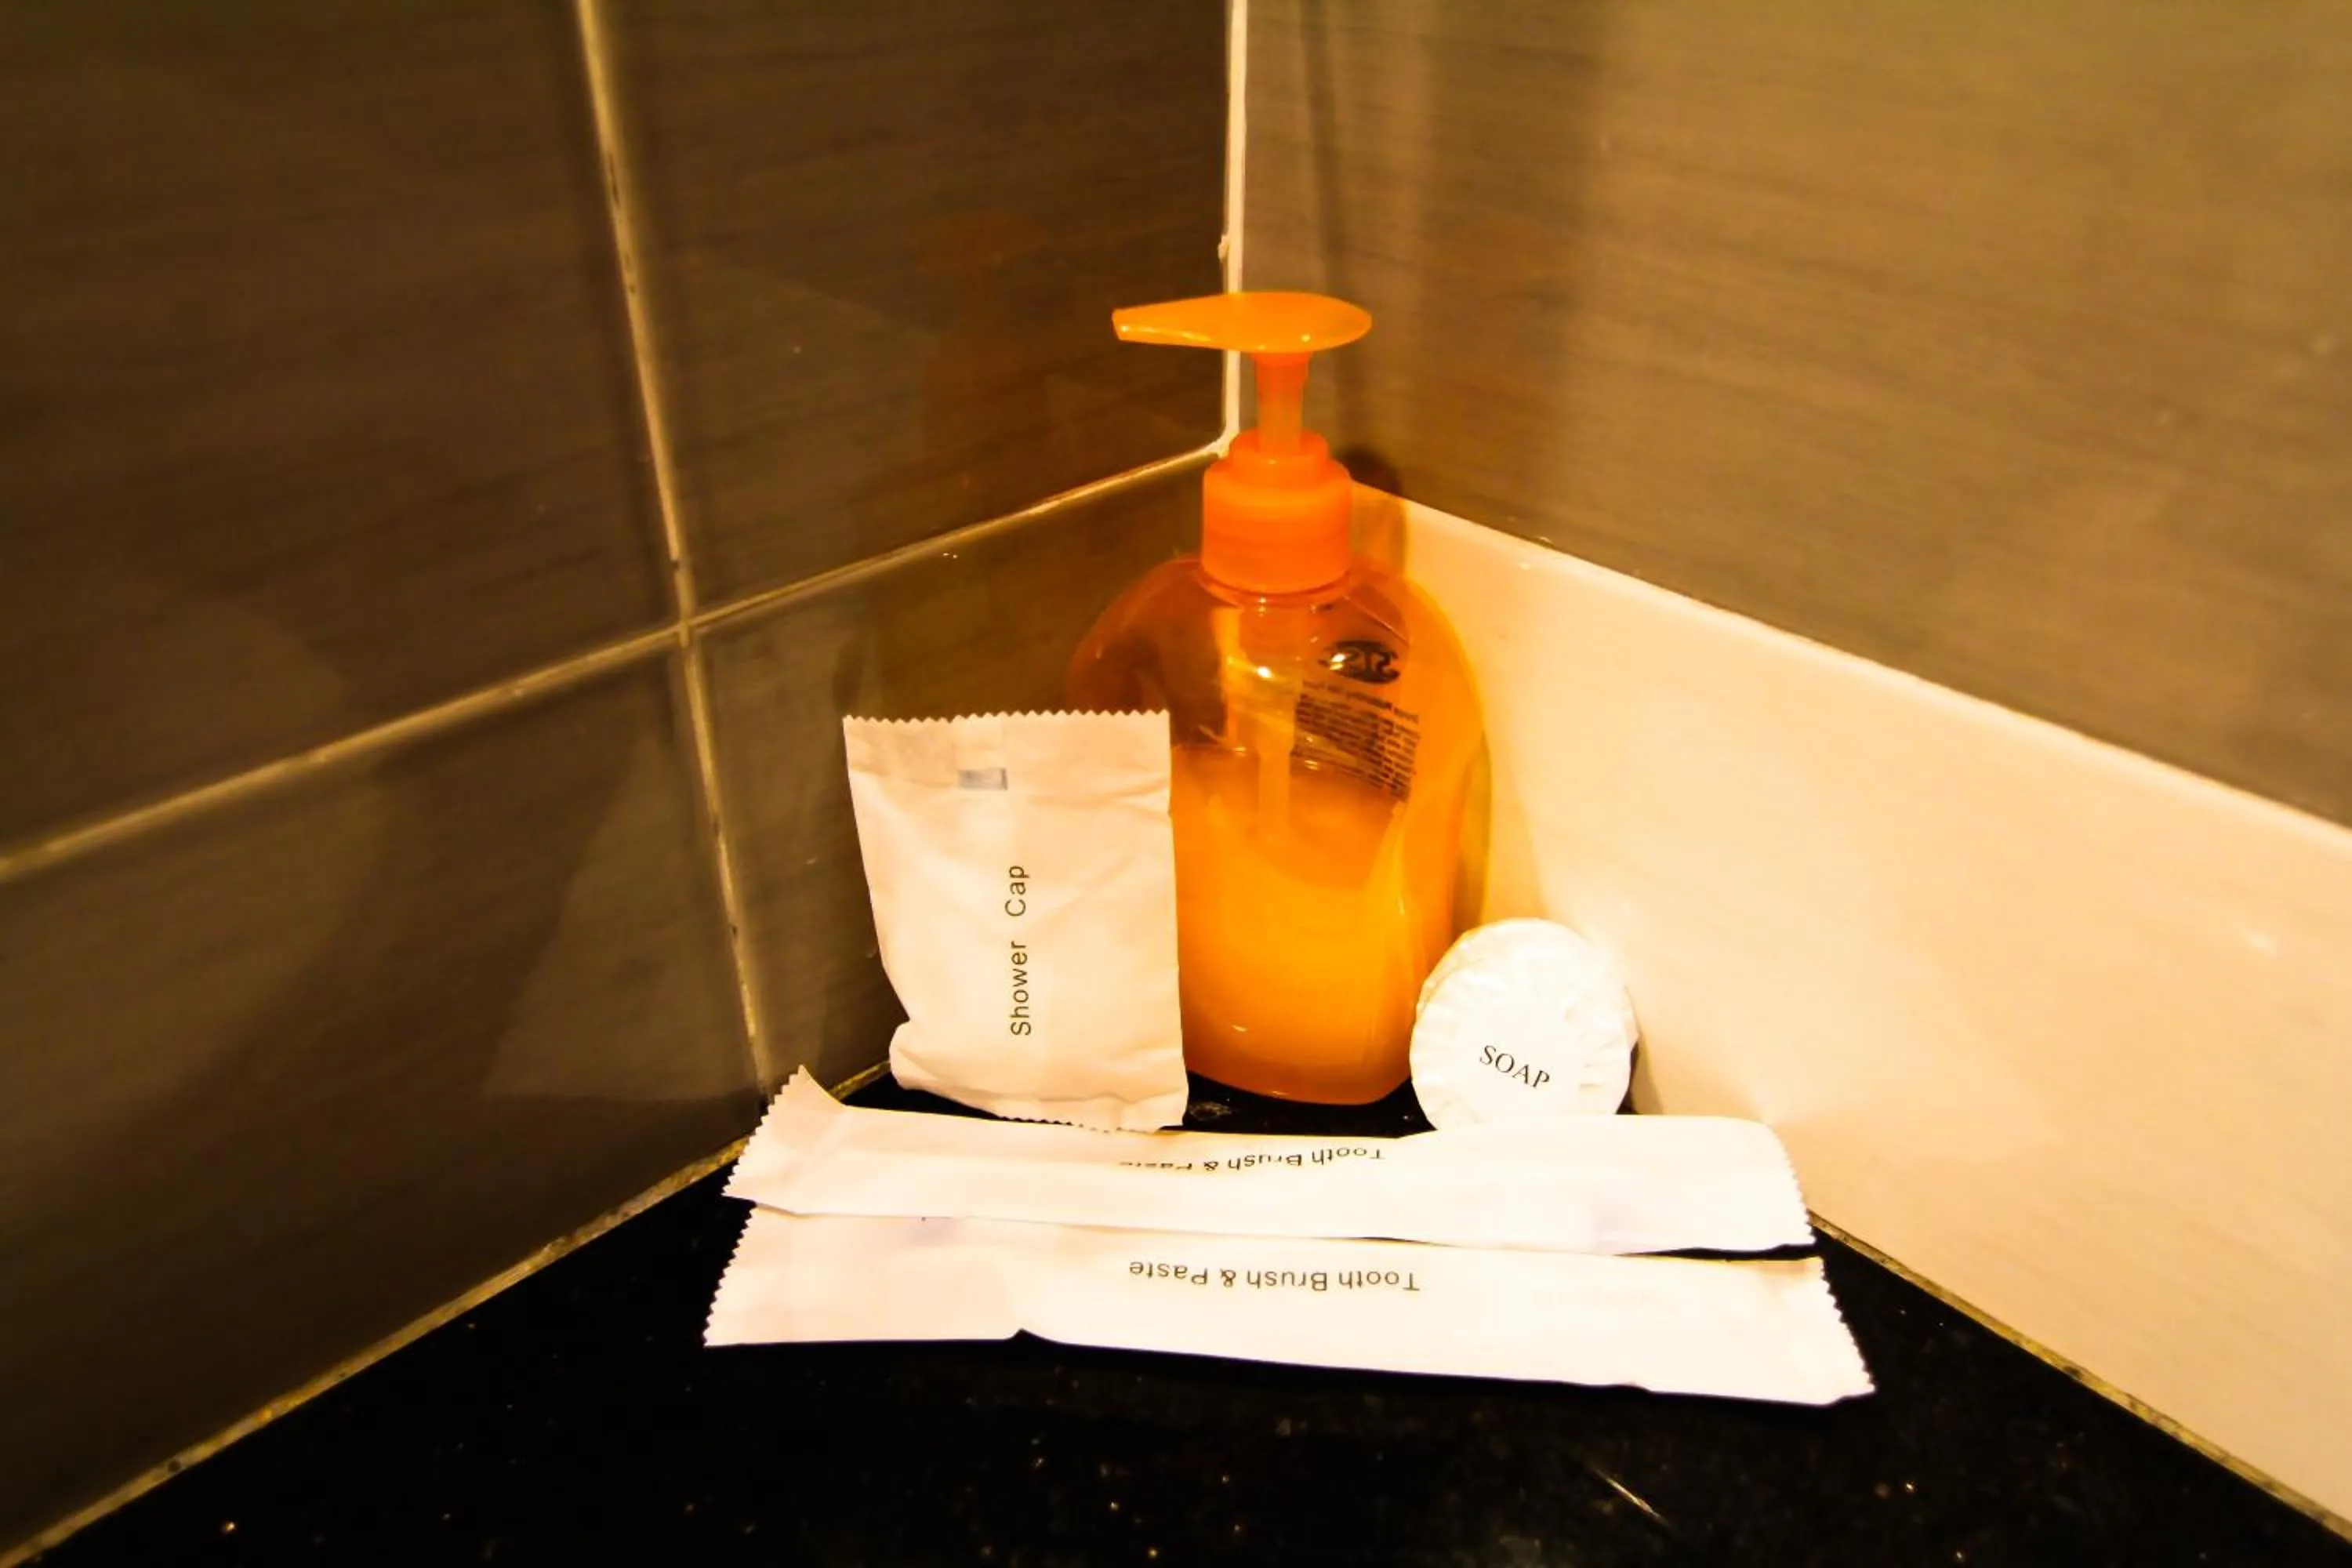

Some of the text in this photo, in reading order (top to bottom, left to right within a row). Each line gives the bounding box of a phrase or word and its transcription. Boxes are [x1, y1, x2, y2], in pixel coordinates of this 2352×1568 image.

[1004, 865, 1033, 1036] Shower Cap
[1479, 1044, 1551, 1089] SOAP
[1203, 1160, 1220, 1172] &
[1227, 1154, 1303, 1171] Brush
[1312, 1147, 1384, 1166] Tooth
[1129, 1261, 1421, 1292] Tooth Brush & Paste
